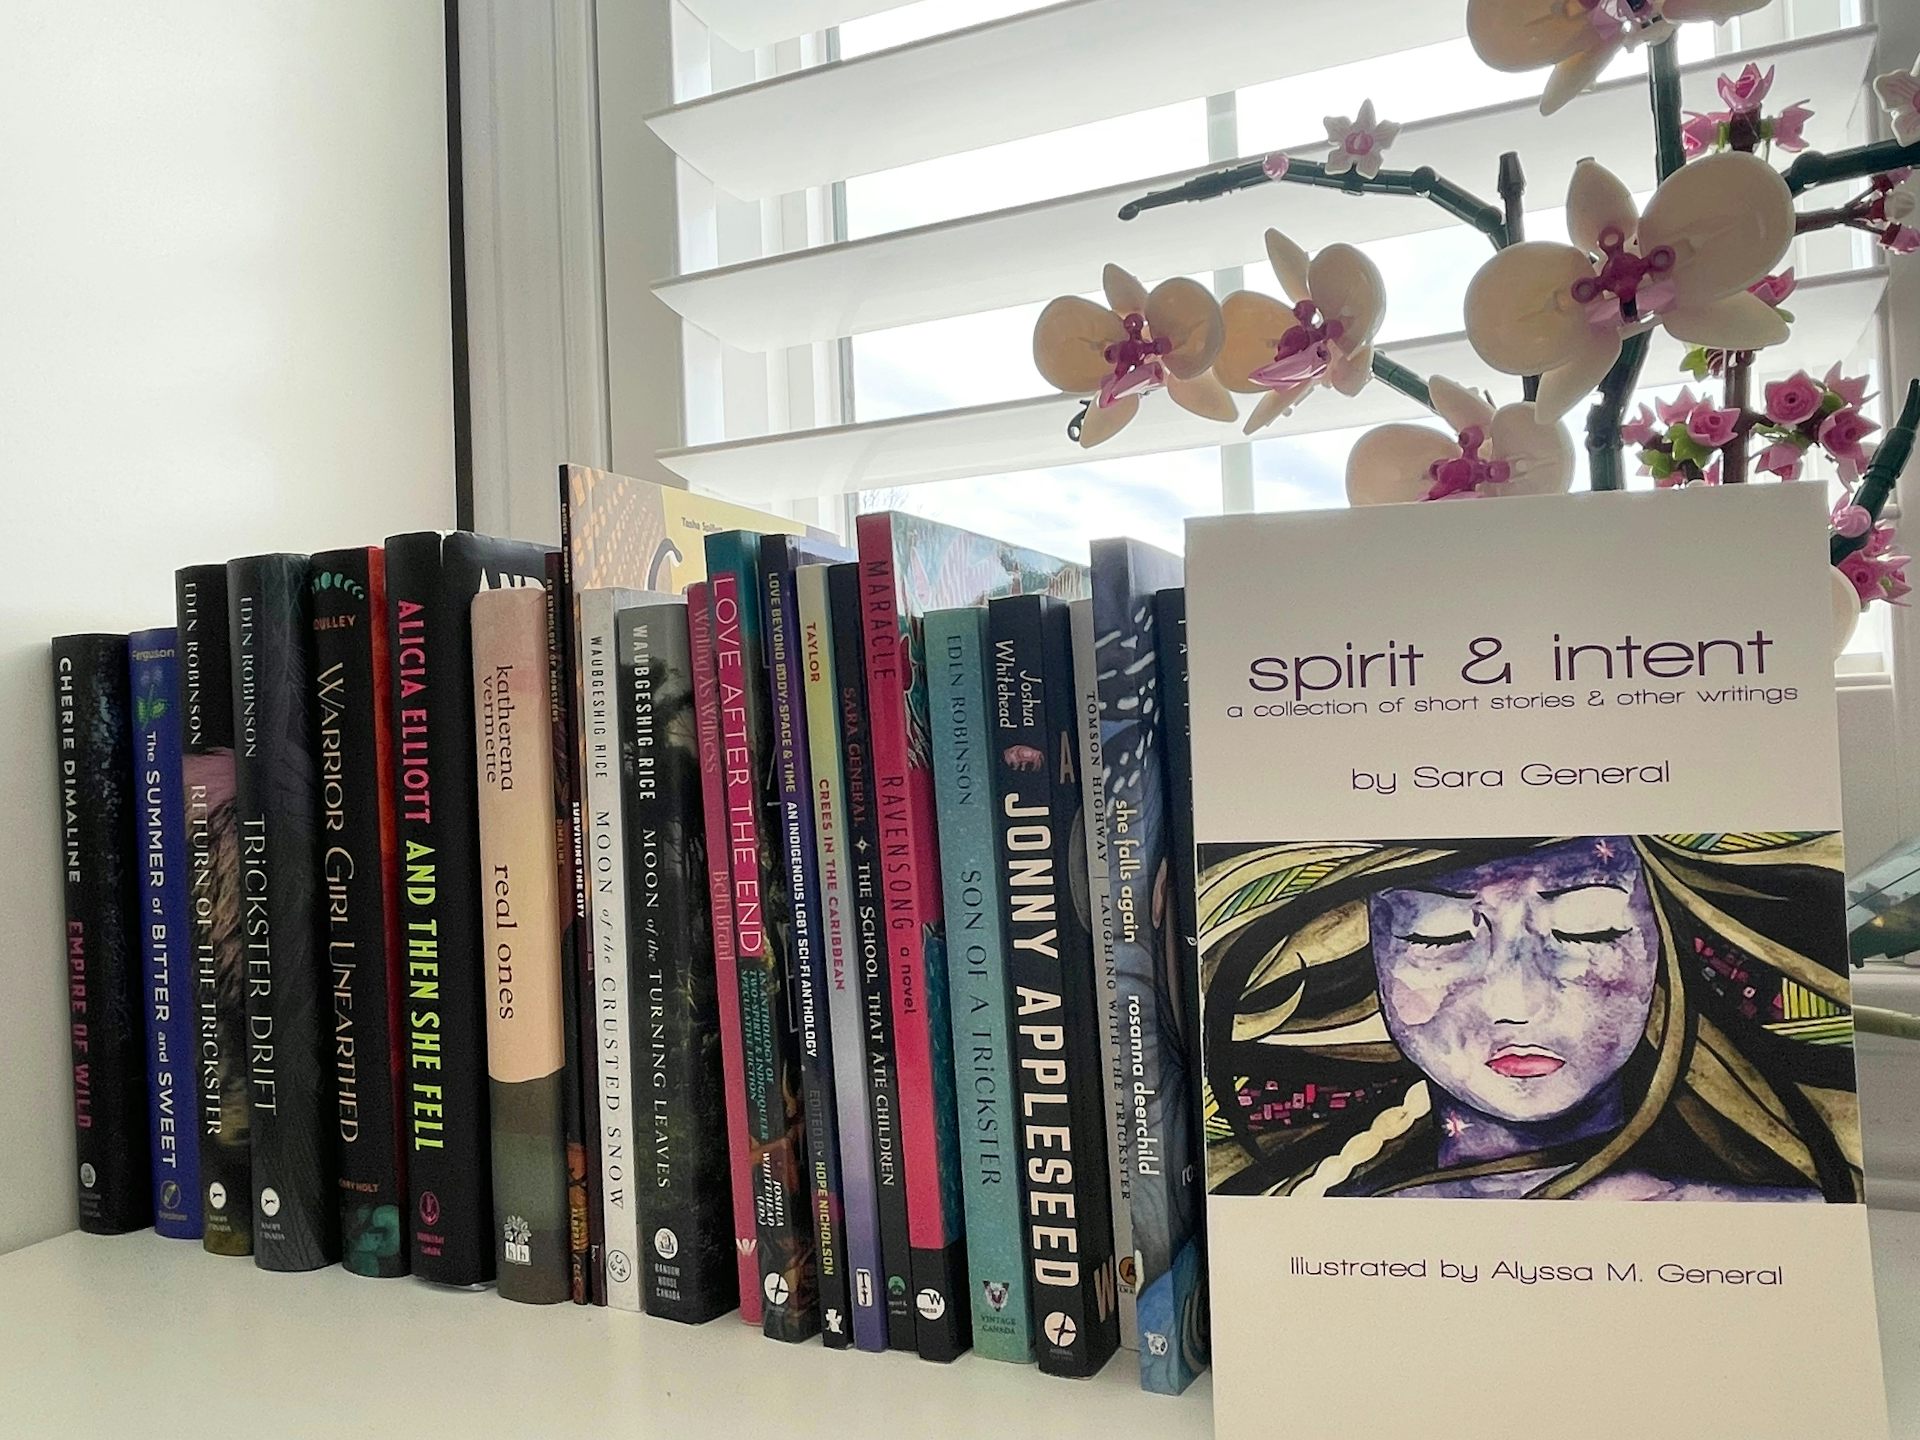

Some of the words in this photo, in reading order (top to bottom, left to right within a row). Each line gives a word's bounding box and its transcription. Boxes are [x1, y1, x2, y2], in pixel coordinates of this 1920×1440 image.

[184, 582, 198, 632] EDEN
[240, 597, 254, 646] EDEN
[768, 573, 782, 605] LOVE
[866, 561, 896, 680] MARACLE
[397, 600, 428, 698] ALICIA
[713, 577, 742, 670] LOVE
[770, 606, 786, 661] BEYOND
[805, 622, 821, 682] TAYLOR
[187, 641, 202, 745] ROBINSON
[591, 636, 605, 735] WAUBGESHIG
[633, 624, 654, 748] WAUBGESHIG
[946, 635, 966, 687] EDEN
[995, 639, 1018, 730] Whitehead
[1249, 640, 1424, 701] spirit
[1461, 636, 1512, 685] &
[1553, 630, 1774, 681] intent
[59, 657, 75, 750] CHERIE
[241, 654, 257, 758] ROBINSON
[483, 676, 497, 784] vermette
[496, 664, 515, 791] katherena
[778, 704, 792, 747] SPACE
[843, 687, 858, 737] SARA
[1019, 669, 1043, 727] Joshua
[1086, 691, 1101, 766] TOMSON
[1226, 705, 1243, 718] a
[1253, 699, 1368, 718] collection
[1378, 697, 1406, 713] of
[1414, 696, 1480, 712] short
[1490, 691, 1575, 710] stories
[1587, 690, 1604, 707] &
[1617, 688, 1685, 705] other
[1697, 685, 1798, 705] writings
[146, 732, 157, 763] The
[316, 662, 346, 831] WARRIOR
[402, 708, 431, 824] ELLIOTT
[594, 744, 608, 778] RICE
[722, 683, 750, 787] AFTER
[782, 750, 792, 760] &
[951, 696, 973, 805] ROBINSON
[637, 757, 656, 800] RICE
[783, 762, 796, 793] TIME
[819, 779, 833, 831] CREES
[849, 744, 866, 822] GENERAL
[1352, 768, 1397, 795] by
[1413, 766, 1504, 788] Sara
[1520, 760, 1670, 786] General
[64, 760, 80, 883] DIMALINE
[146, 770, 164, 887] SUMMER
[191, 785, 211, 889] RETURN
[572, 802, 583, 866] SURVIVING
[730, 799, 756, 865] THE
[785, 802, 798, 820] AN
[1092, 777, 1108, 863] HIGHWAY
[1116, 800, 1137, 833] she
[405, 840, 436, 906] AND
[596, 811, 613, 894] MOON
[642, 829, 660, 908] MOON
[787, 821, 804, 902] INDIGENOUS
[823, 836, 835, 853] IN
[825, 860, 838, 891] THE
[1004, 792, 1060, 960] JONNY
[1113, 838, 1141, 881] falls
[152, 898, 163, 916] of
[494, 864, 518, 929] real
[576, 868, 584, 892] THE
[577, 894, 586, 919] CITY
[858, 862, 873, 899] THE
[881, 775, 915, 929] RAVENSONG
[901, 964, 917, 1014] novel
[961, 870, 984, 931] SON
[600, 908, 613, 932] of
[645, 918, 659, 938] of
[735, 880, 762, 952] END
[794, 903, 807, 935] LGBT
[828, 897, 846, 990] CARIBBEAN
[860, 906, 879, 984] SCHOOL
[1100, 894, 1117, 990] LAUGHING
[1117, 885, 1140, 943] again
[68, 921, 86, 1013] EMPIRE
[152, 924, 170, 1021] BITTER
[198, 941, 216, 990] THE
[408, 919, 440, 1000] THEN
[497, 944, 514, 1020] ones
[603, 935, 614, 964] the
[647, 938, 660, 962] the
[797, 937, 811, 977] SCI-FI
[966, 945, 988, 982] OF
[648, 969, 668, 1090] TURNING
[760, 990, 773, 1065] ANTHOLOGY
[800, 980, 817, 1058] ANTHOLOGY
[867, 991, 884, 1043] THAT
[969, 994, 990, 1014] A
[1109, 1000, 1121, 1045] WITH
[1127, 994, 1145, 1077] rosanna
[72, 1024, 88, 1053] OF
[158, 1031, 169, 1063] and
[250, 1016, 277, 1116] DRIFT
[410, 1011, 442, 1071] SHE
[602, 977, 620, 1111] CRUSTED
[872, 1052, 888, 1089] ATE
[74, 1063, 92, 1128] WILD
[1112, 1054, 1124, 1091] THE
[158, 1072, 177, 1168] SWEET
[413, 1083, 445, 1151] FELL
[653, 1099, 671, 1189] LEAVES
[809, 1089, 824, 1139] EDITED
[876, 1095, 895, 1187] CHILDREN
[1015, 985, 1080, 1287] APPLESEED
[1133, 1083, 1160, 1176] deerchild
[607, 1126, 624, 1210] SNOW
[815, 1161, 828, 1196] HOPE
[1115, 1101, 1131, 1200] TRICKSTER
[761, 1152, 776, 1227] WHITEHEAD
[773, 1180, 785, 1228] JOSHUA
[817, 1199, 834, 1276] NICHOLSON
[1290, 1256, 1427, 1278] Illustrated
[1440, 1258, 1479, 1283] by
[1491, 1260, 1594, 1285] Alyssa
[1606, 1262, 1643, 1283] M.
[1657, 1262, 1784, 1286] General
